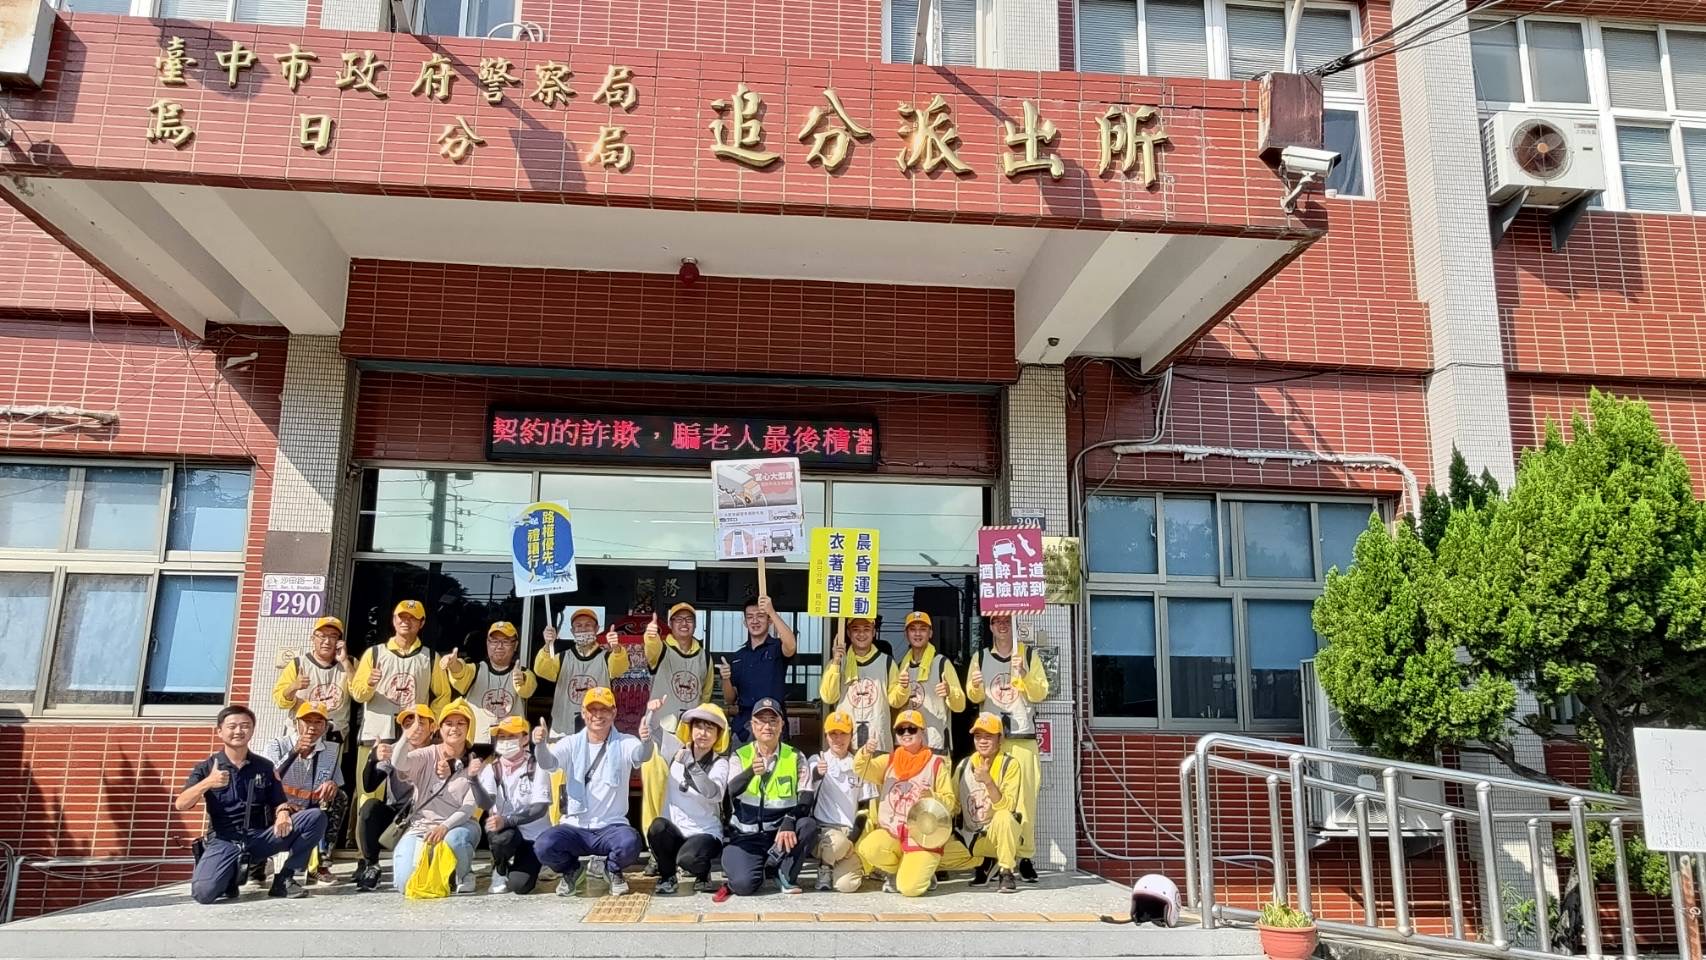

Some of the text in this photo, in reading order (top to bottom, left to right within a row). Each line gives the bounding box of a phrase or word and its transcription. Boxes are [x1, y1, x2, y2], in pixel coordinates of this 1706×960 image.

[155, 36, 639, 112] 臺中市政府警察局
[147, 98, 634, 171] 烏日分局
[709, 82, 1169, 189] 追分派出所
[542, 510, 555, 564] 路權優先
[827, 533, 845, 613] 衣著醒目
[979, 562, 1044, 579] 酒醉上道
[275, 592, 321, 615] 290
[854, 533, 871, 615] 晨昏運動
[979, 580, 1045, 598] 危險就到
